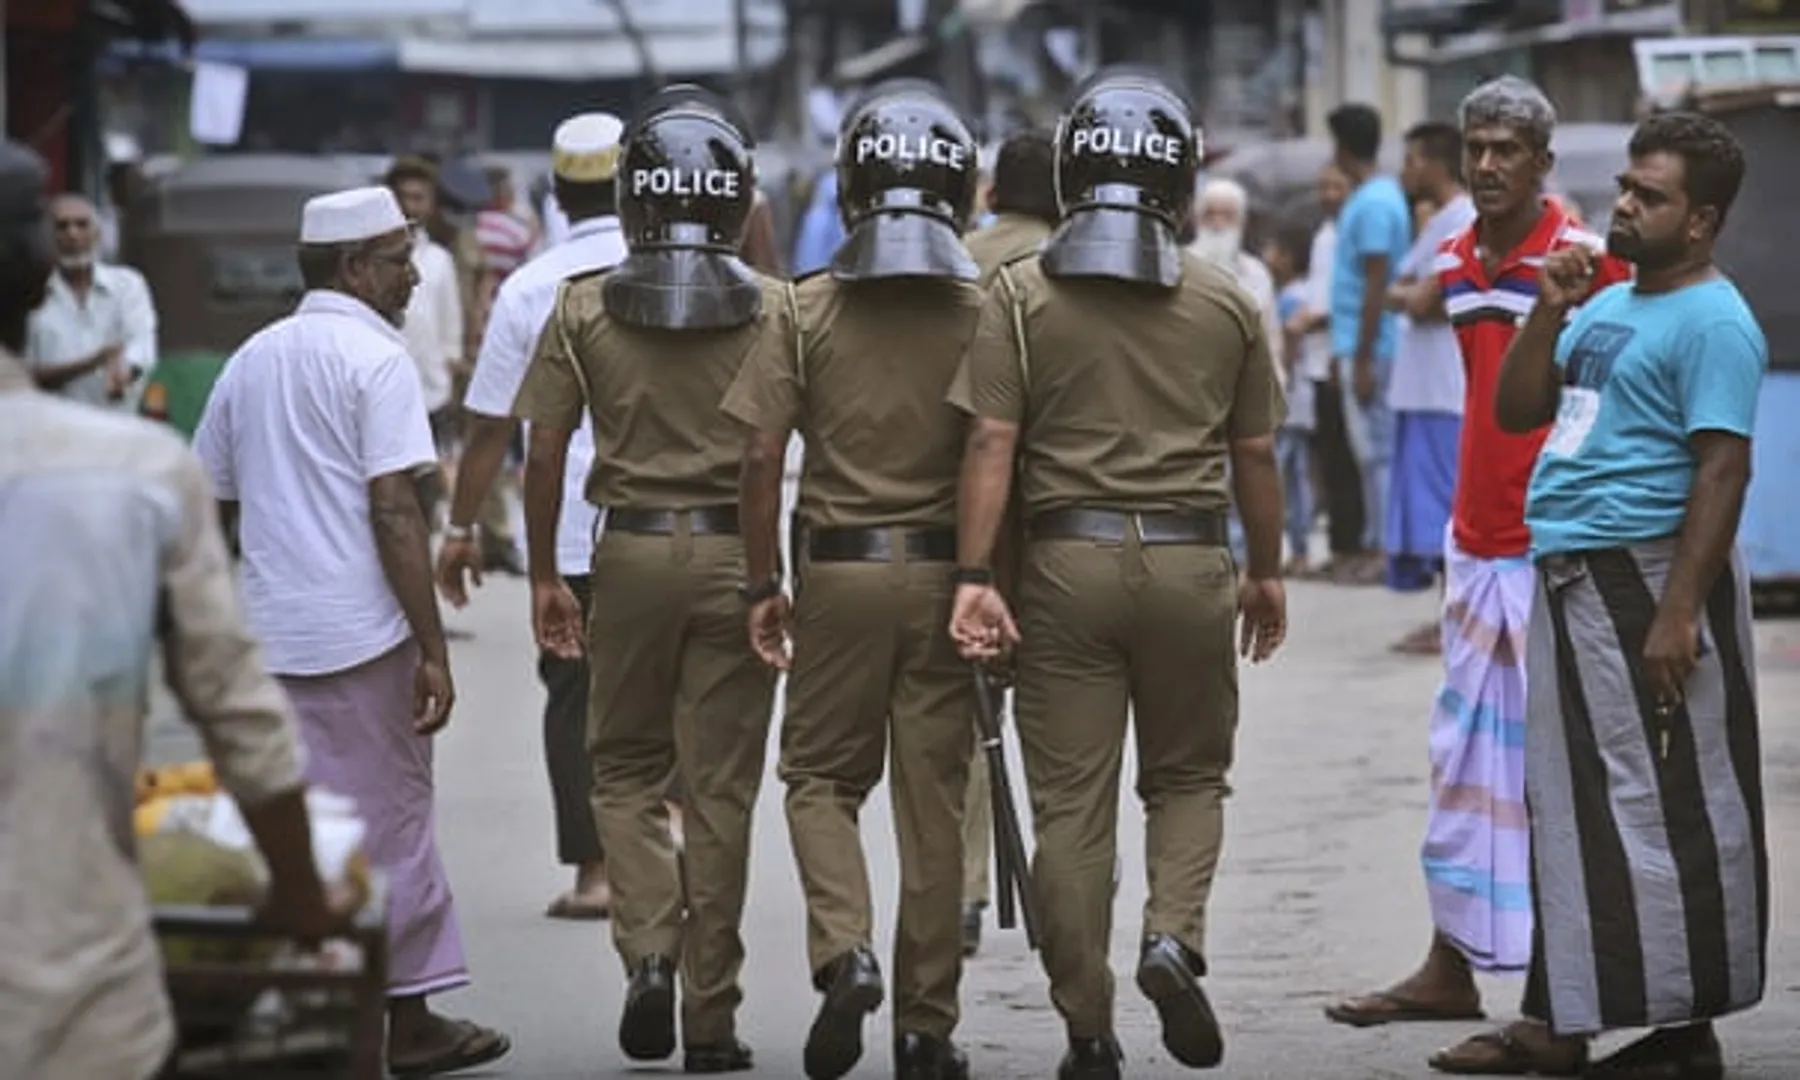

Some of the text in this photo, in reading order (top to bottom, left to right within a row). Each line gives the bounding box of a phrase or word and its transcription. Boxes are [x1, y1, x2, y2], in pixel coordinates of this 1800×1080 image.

[857, 133, 964, 171] POLICE
[1073, 127, 1181, 165] POLICE
[633, 167, 739, 197] POLICE
